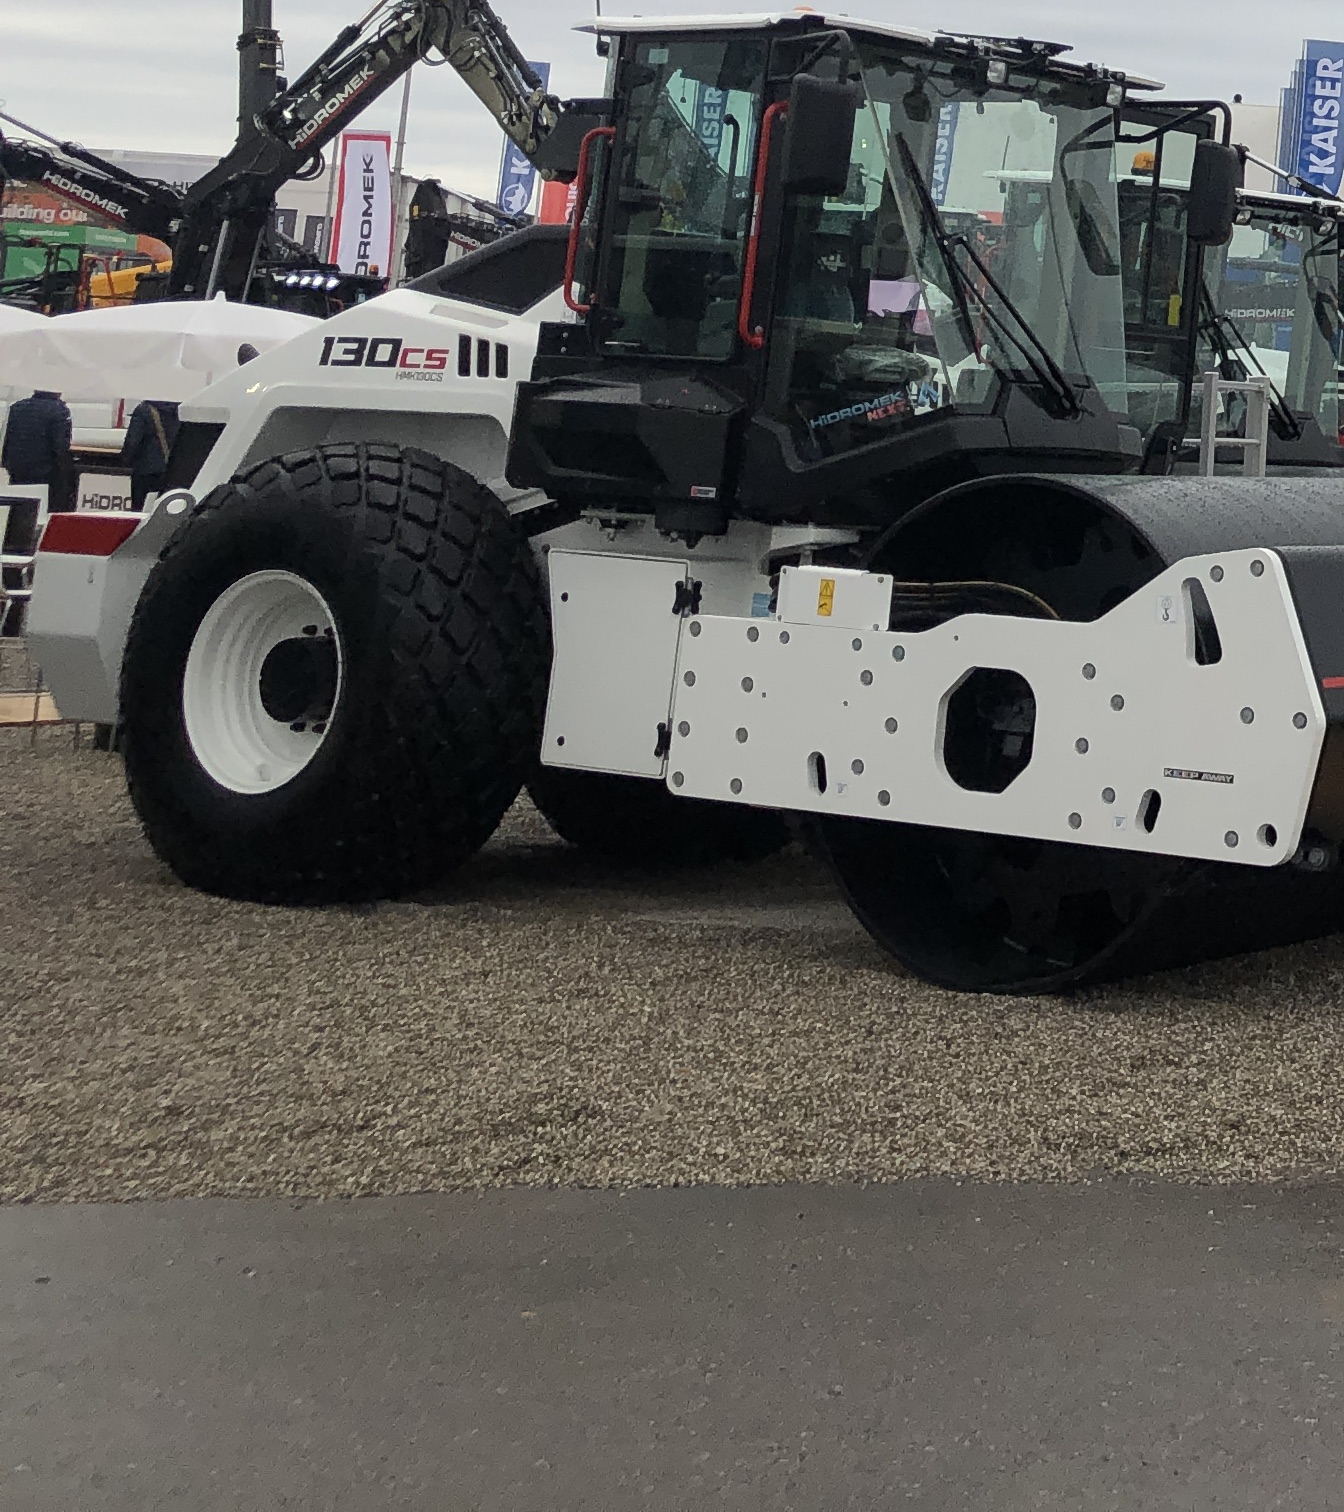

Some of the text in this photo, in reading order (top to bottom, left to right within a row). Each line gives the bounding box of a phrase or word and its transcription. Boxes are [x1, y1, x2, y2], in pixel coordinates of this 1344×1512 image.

[1309, 57, 1344, 175] KAISER
[1164, 769, 1233, 783] KEEP AWAY
